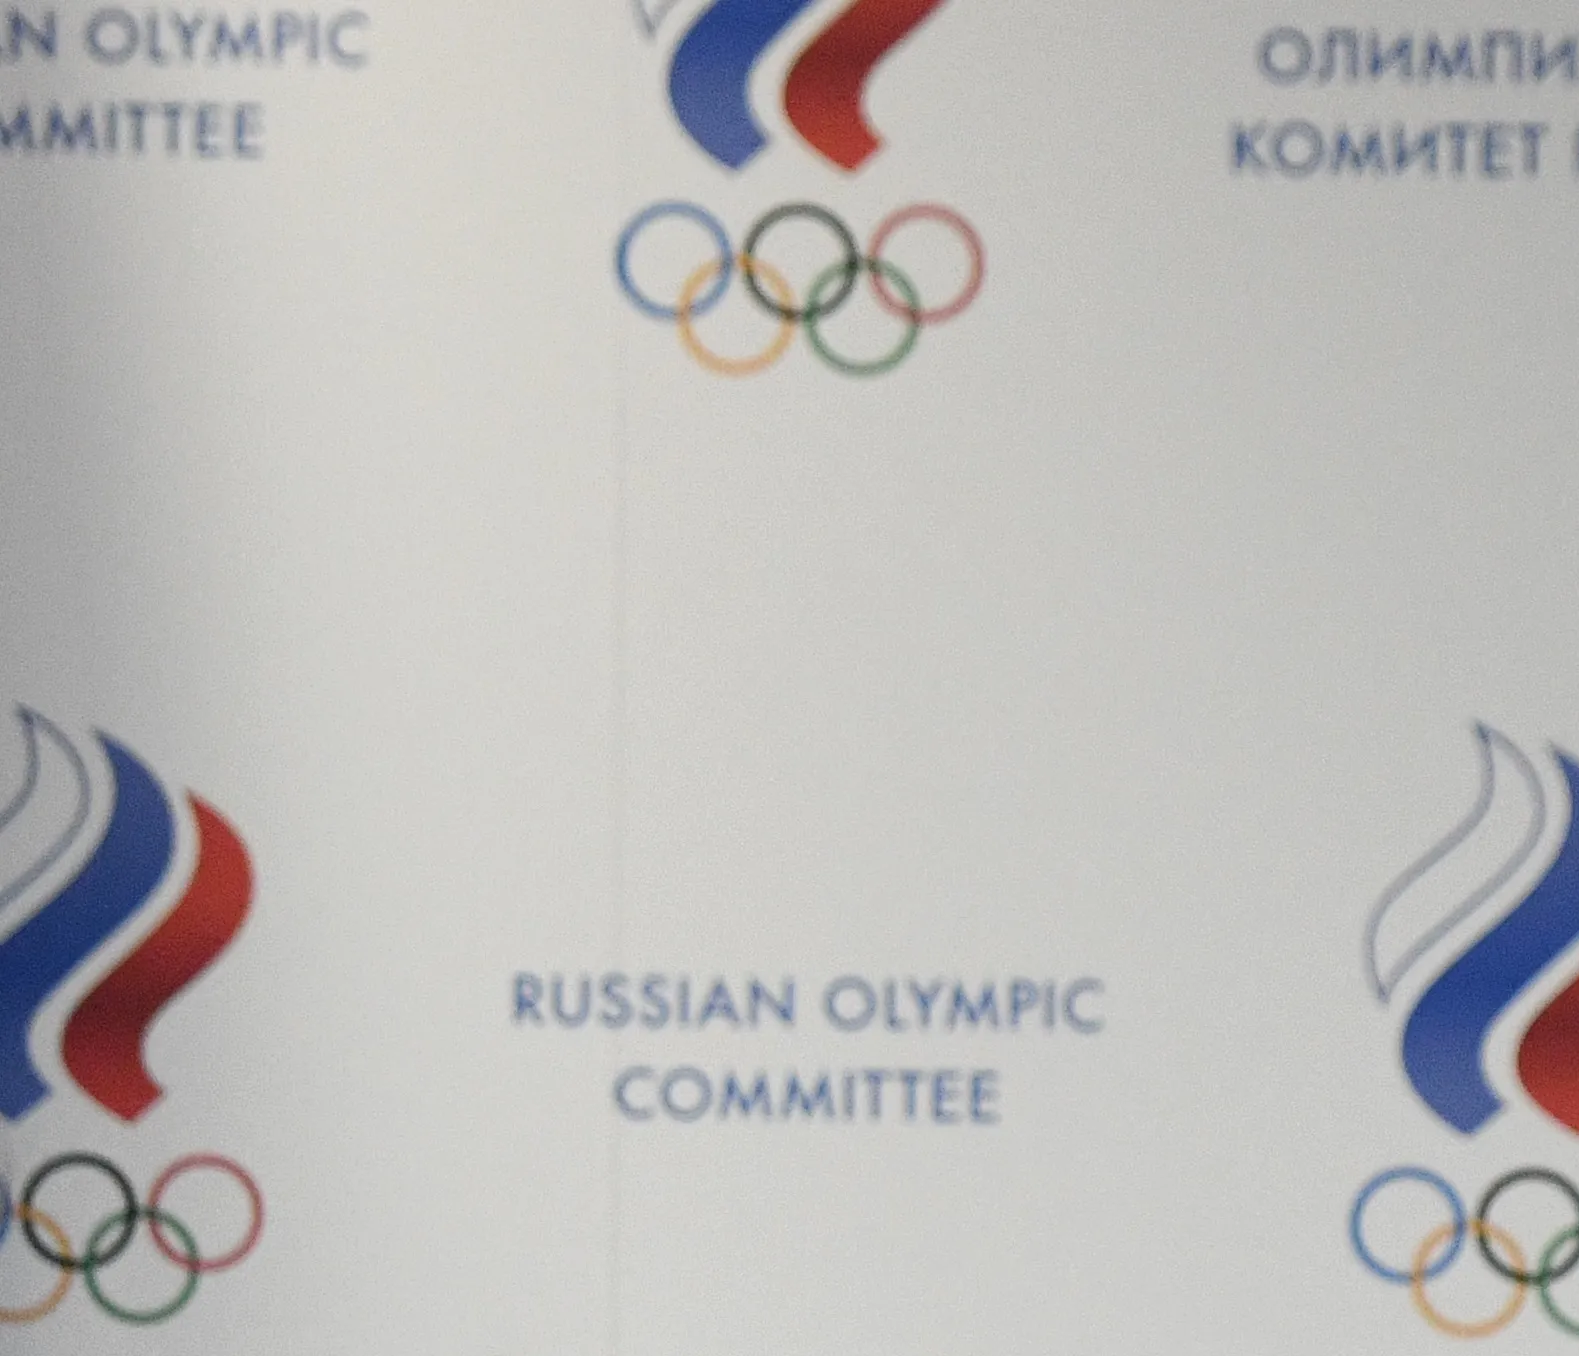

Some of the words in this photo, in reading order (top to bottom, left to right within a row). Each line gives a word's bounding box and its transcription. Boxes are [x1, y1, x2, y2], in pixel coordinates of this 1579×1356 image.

[84, 8, 370, 70] OLYMPIC
[1229, 119, 1549, 181] КОМИТЕТ
[510, 971, 797, 1031] RUSSIAN
[821, 975, 1108, 1036] OLYMPIC
[611, 1065, 1002, 1126] COMMITTEE
